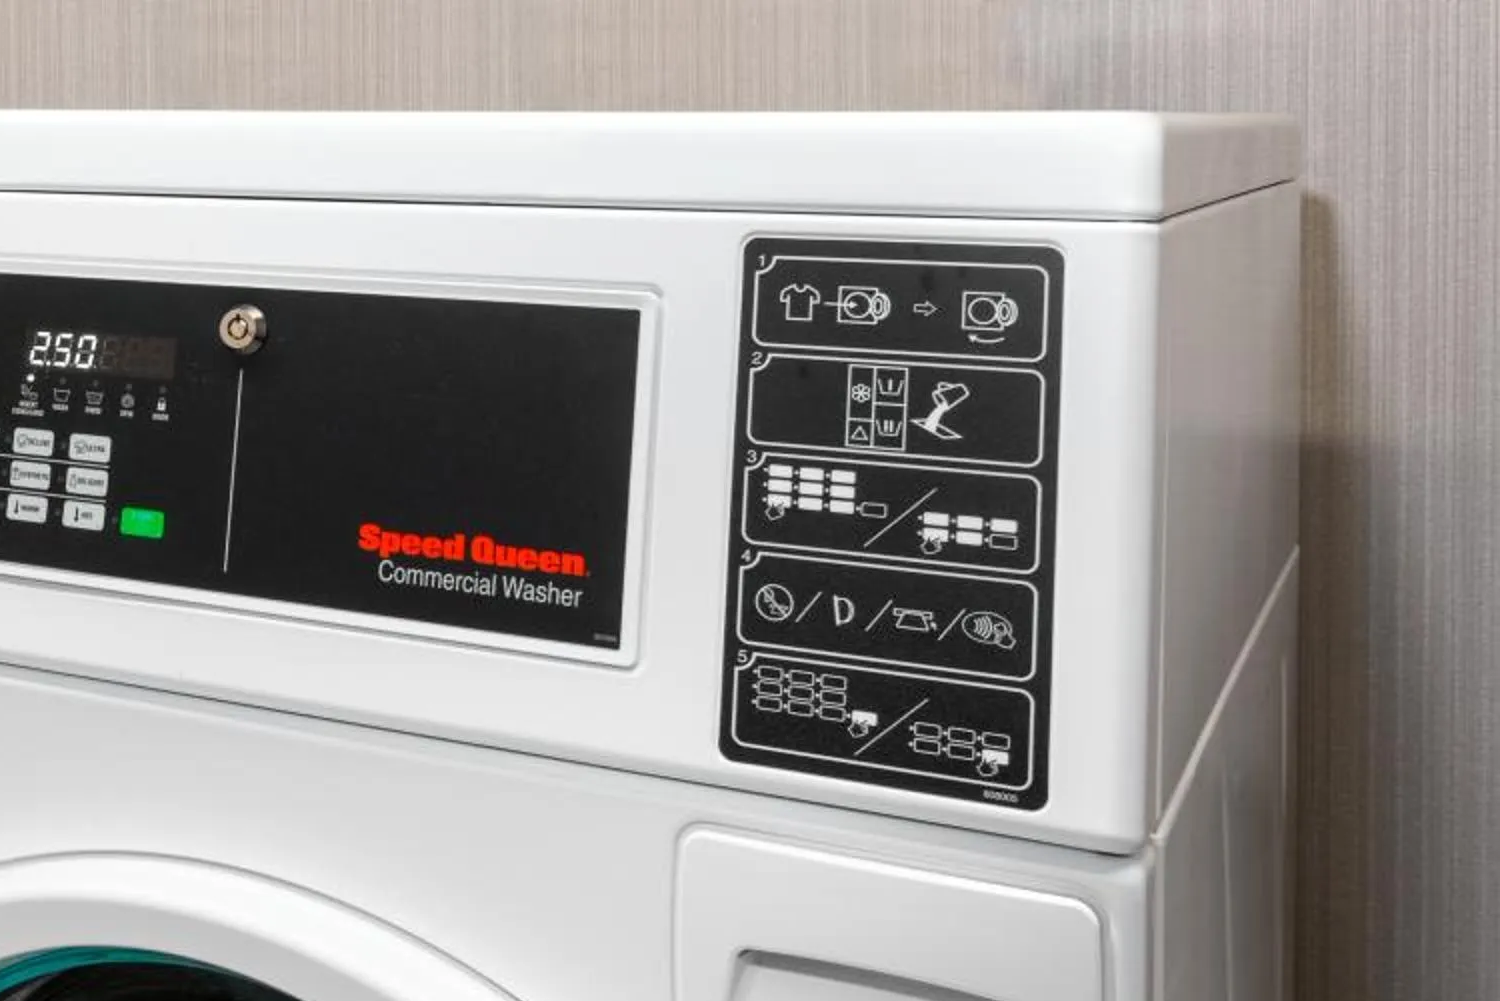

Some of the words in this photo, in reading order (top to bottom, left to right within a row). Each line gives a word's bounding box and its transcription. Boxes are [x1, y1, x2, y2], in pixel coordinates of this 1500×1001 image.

[758, 254, 766, 268] 1
[29, 331, 98, 369] 2.50
[751, 351, 764, 366] 2
[747, 449, 758, 464] 3
[358, 522, 465, 560] Speed
[471, 535, 586, 577] Queen
[378, 559, 497, 597] Commercial
[501, 575, 584, 607] Washer
[737, 648, 749, 664] 5
